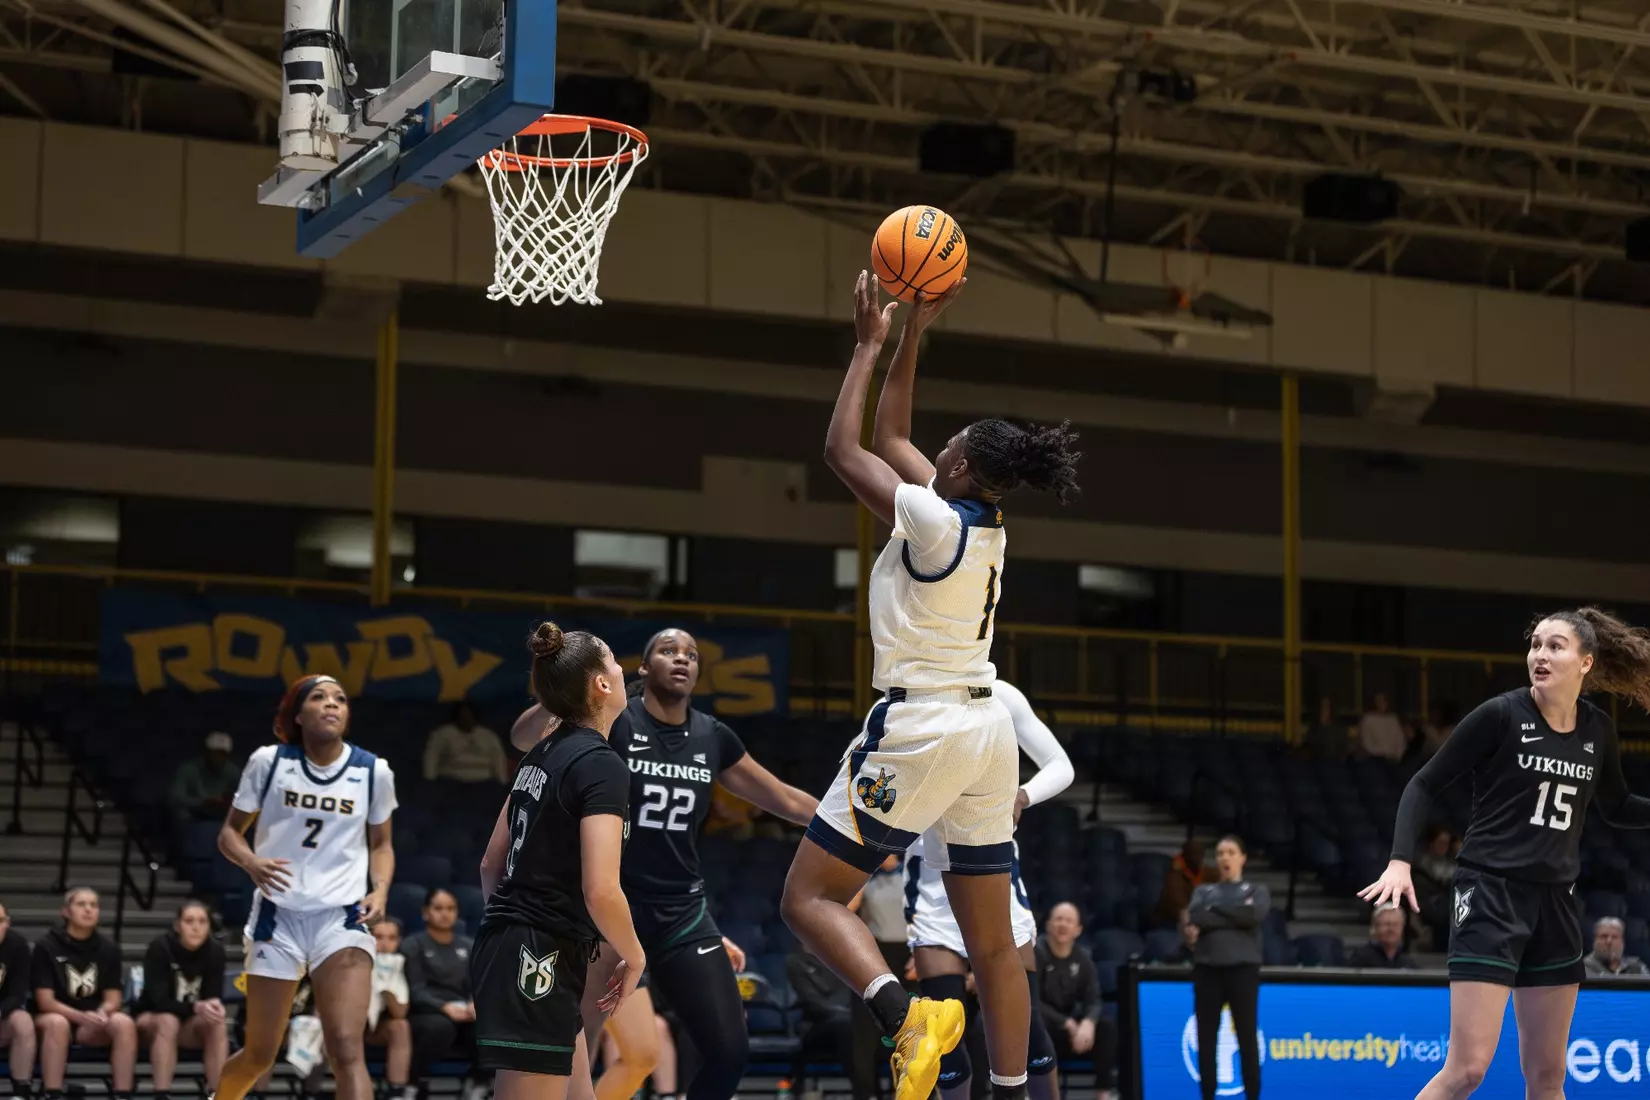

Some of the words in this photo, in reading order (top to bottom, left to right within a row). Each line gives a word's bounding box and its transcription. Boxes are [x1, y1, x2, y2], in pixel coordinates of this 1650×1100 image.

[976, 562, 997, 640] 1
[123, 612, 505, 703] ROWDY
[627, 758, 711, 783] VIKINGS
[1517, 753, 1594, 780] VIKINGS
[284, 790, 355, 814] ROOS
[638, 783, 696, 831] 22
[1529, 780, 1578, 831] 15
[302, 818, 323, 849] 2
